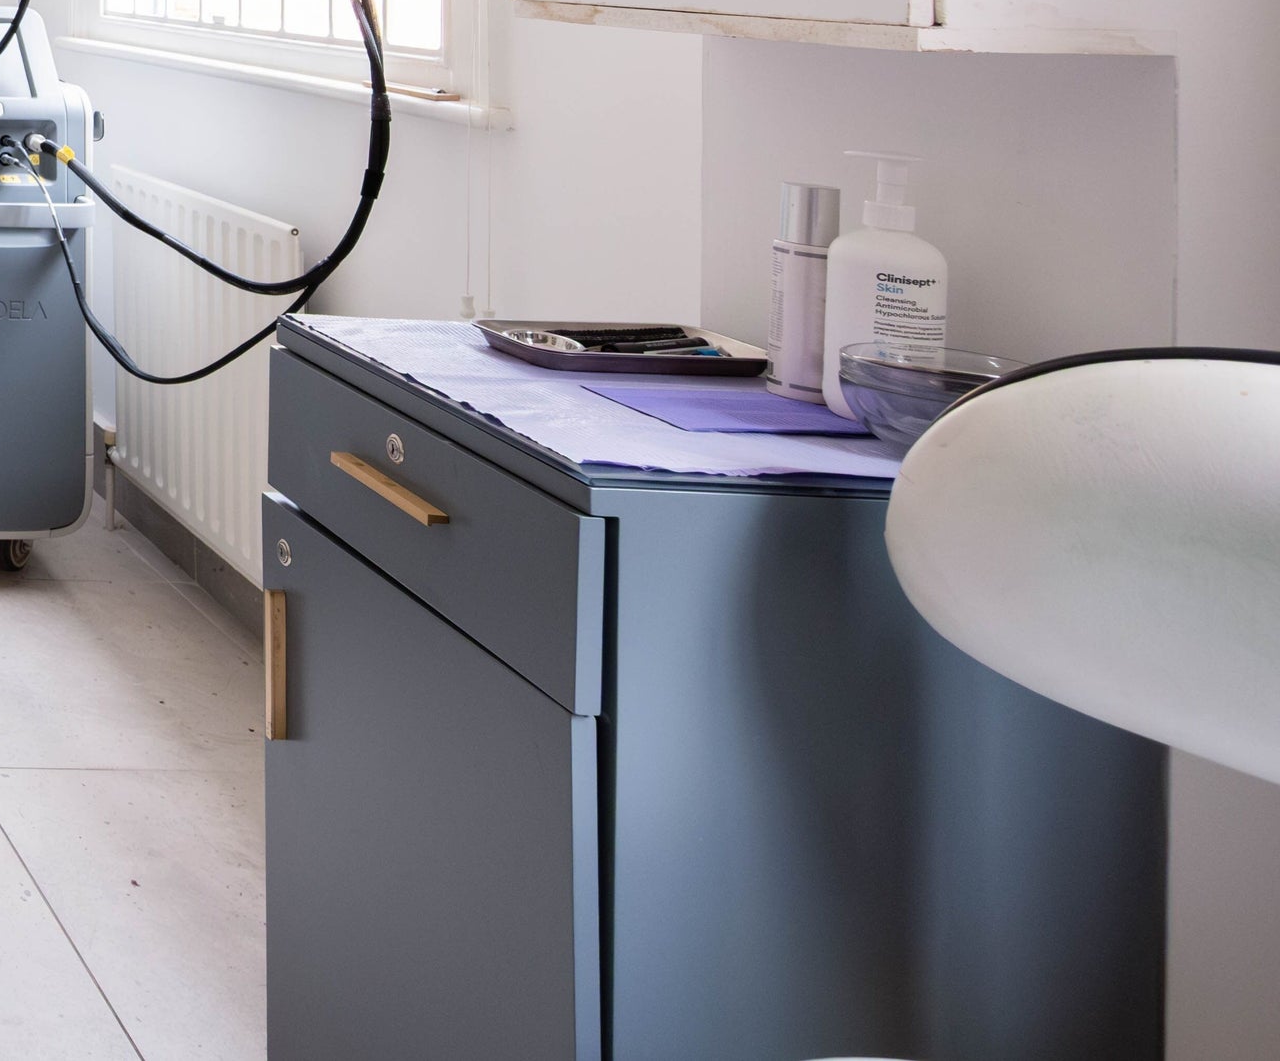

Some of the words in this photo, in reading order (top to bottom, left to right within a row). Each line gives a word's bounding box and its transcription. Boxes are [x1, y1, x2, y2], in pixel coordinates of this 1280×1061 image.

[876, 282, 904, 294] Skin
[875, 294, 917, 306] Cleansing
[875, 301, 929, 313] Antimicrobial
[874, 308, 930, 321] Hypochlorous
